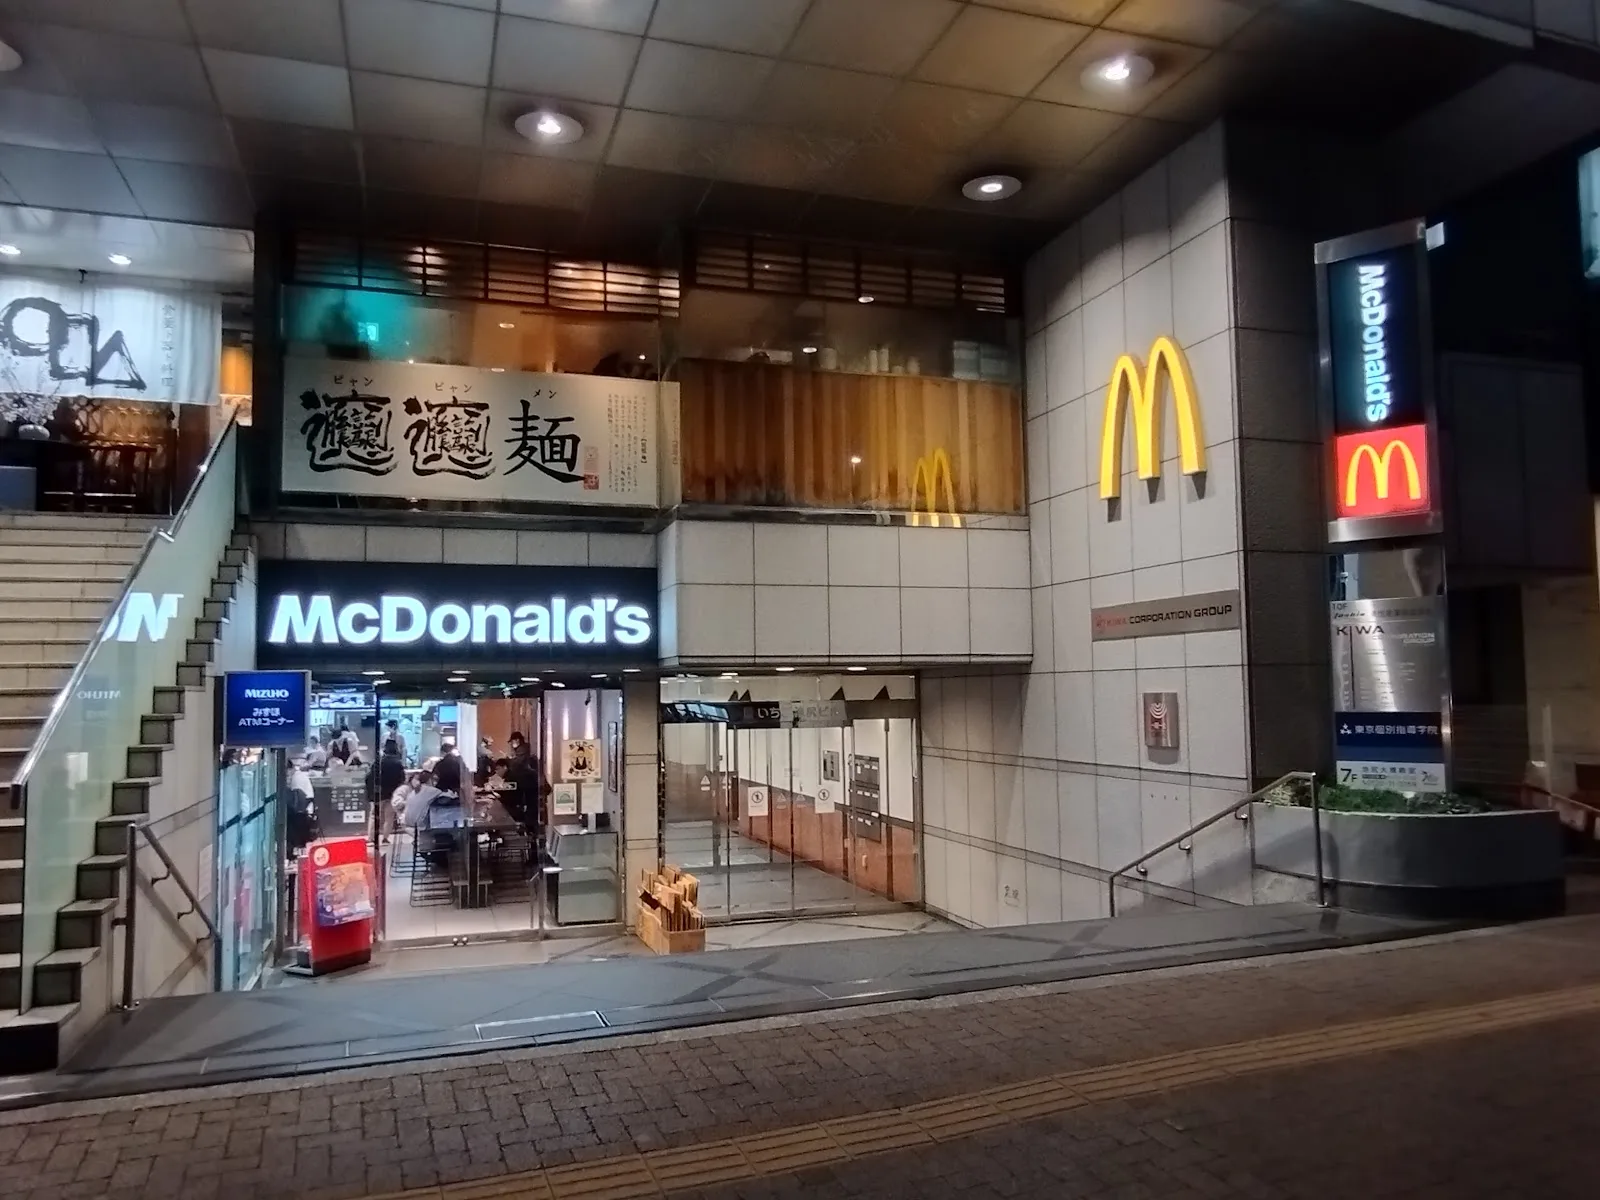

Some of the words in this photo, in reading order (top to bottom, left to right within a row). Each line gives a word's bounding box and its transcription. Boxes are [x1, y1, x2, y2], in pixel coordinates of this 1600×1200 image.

[1358, 264, 1393, 422] McDonald's
[532, 388, 557, 399] メン
[267, 594, 652, 645] McDonald's
[1129, 609, 1192, 624] CORPORATION
[1194, 604, 1233, 618] GROUP
[244, 689, 289, 698] MIZUHO
[252, 707, 281, 717] みずほ
[238, 717, 294, 726] ATMコーナー
[1340, 767, 1358, 782] 7F
